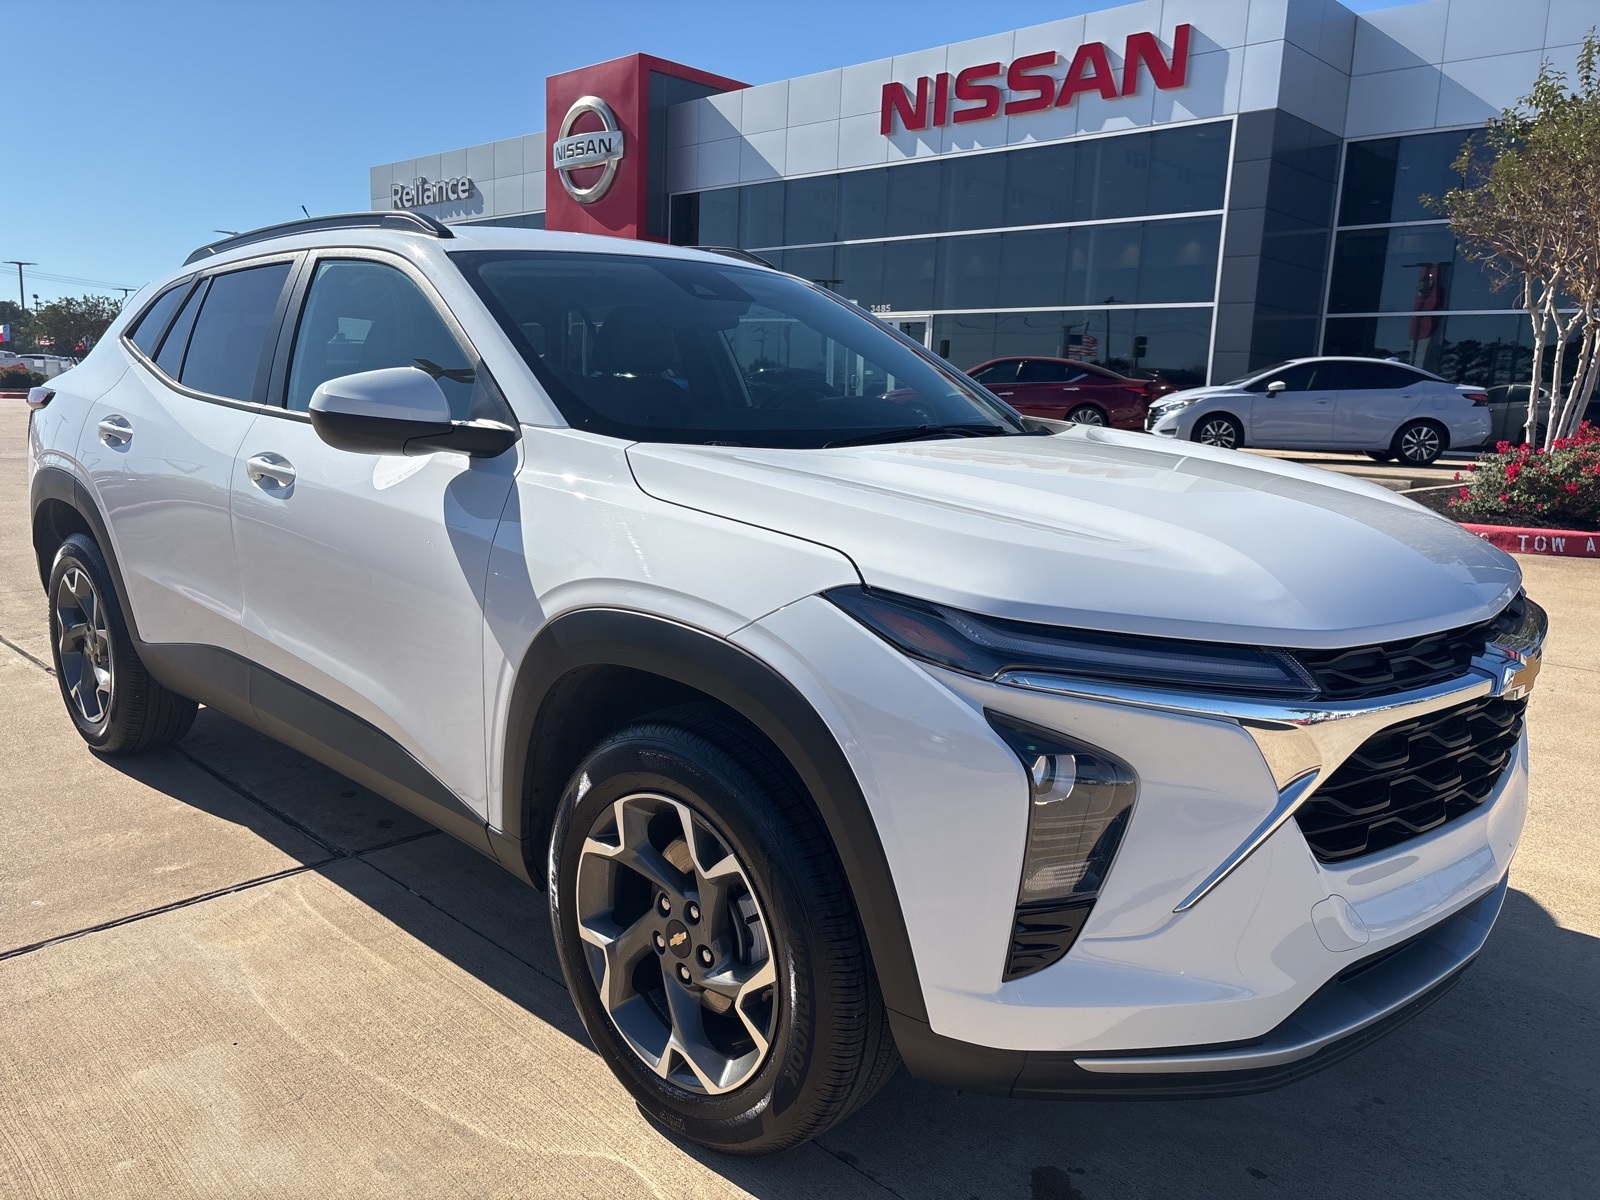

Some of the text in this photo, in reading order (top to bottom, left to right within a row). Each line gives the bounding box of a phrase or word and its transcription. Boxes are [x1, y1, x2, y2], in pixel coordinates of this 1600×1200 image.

[880, 23, 1191, 136] NISSAN
[555, 137, 612, 162] NISSAN
[391, 176, 471, 210] Reliance
[870, 304, 892, 313] 3485
[1517, 534, 1566, 553] TOW
